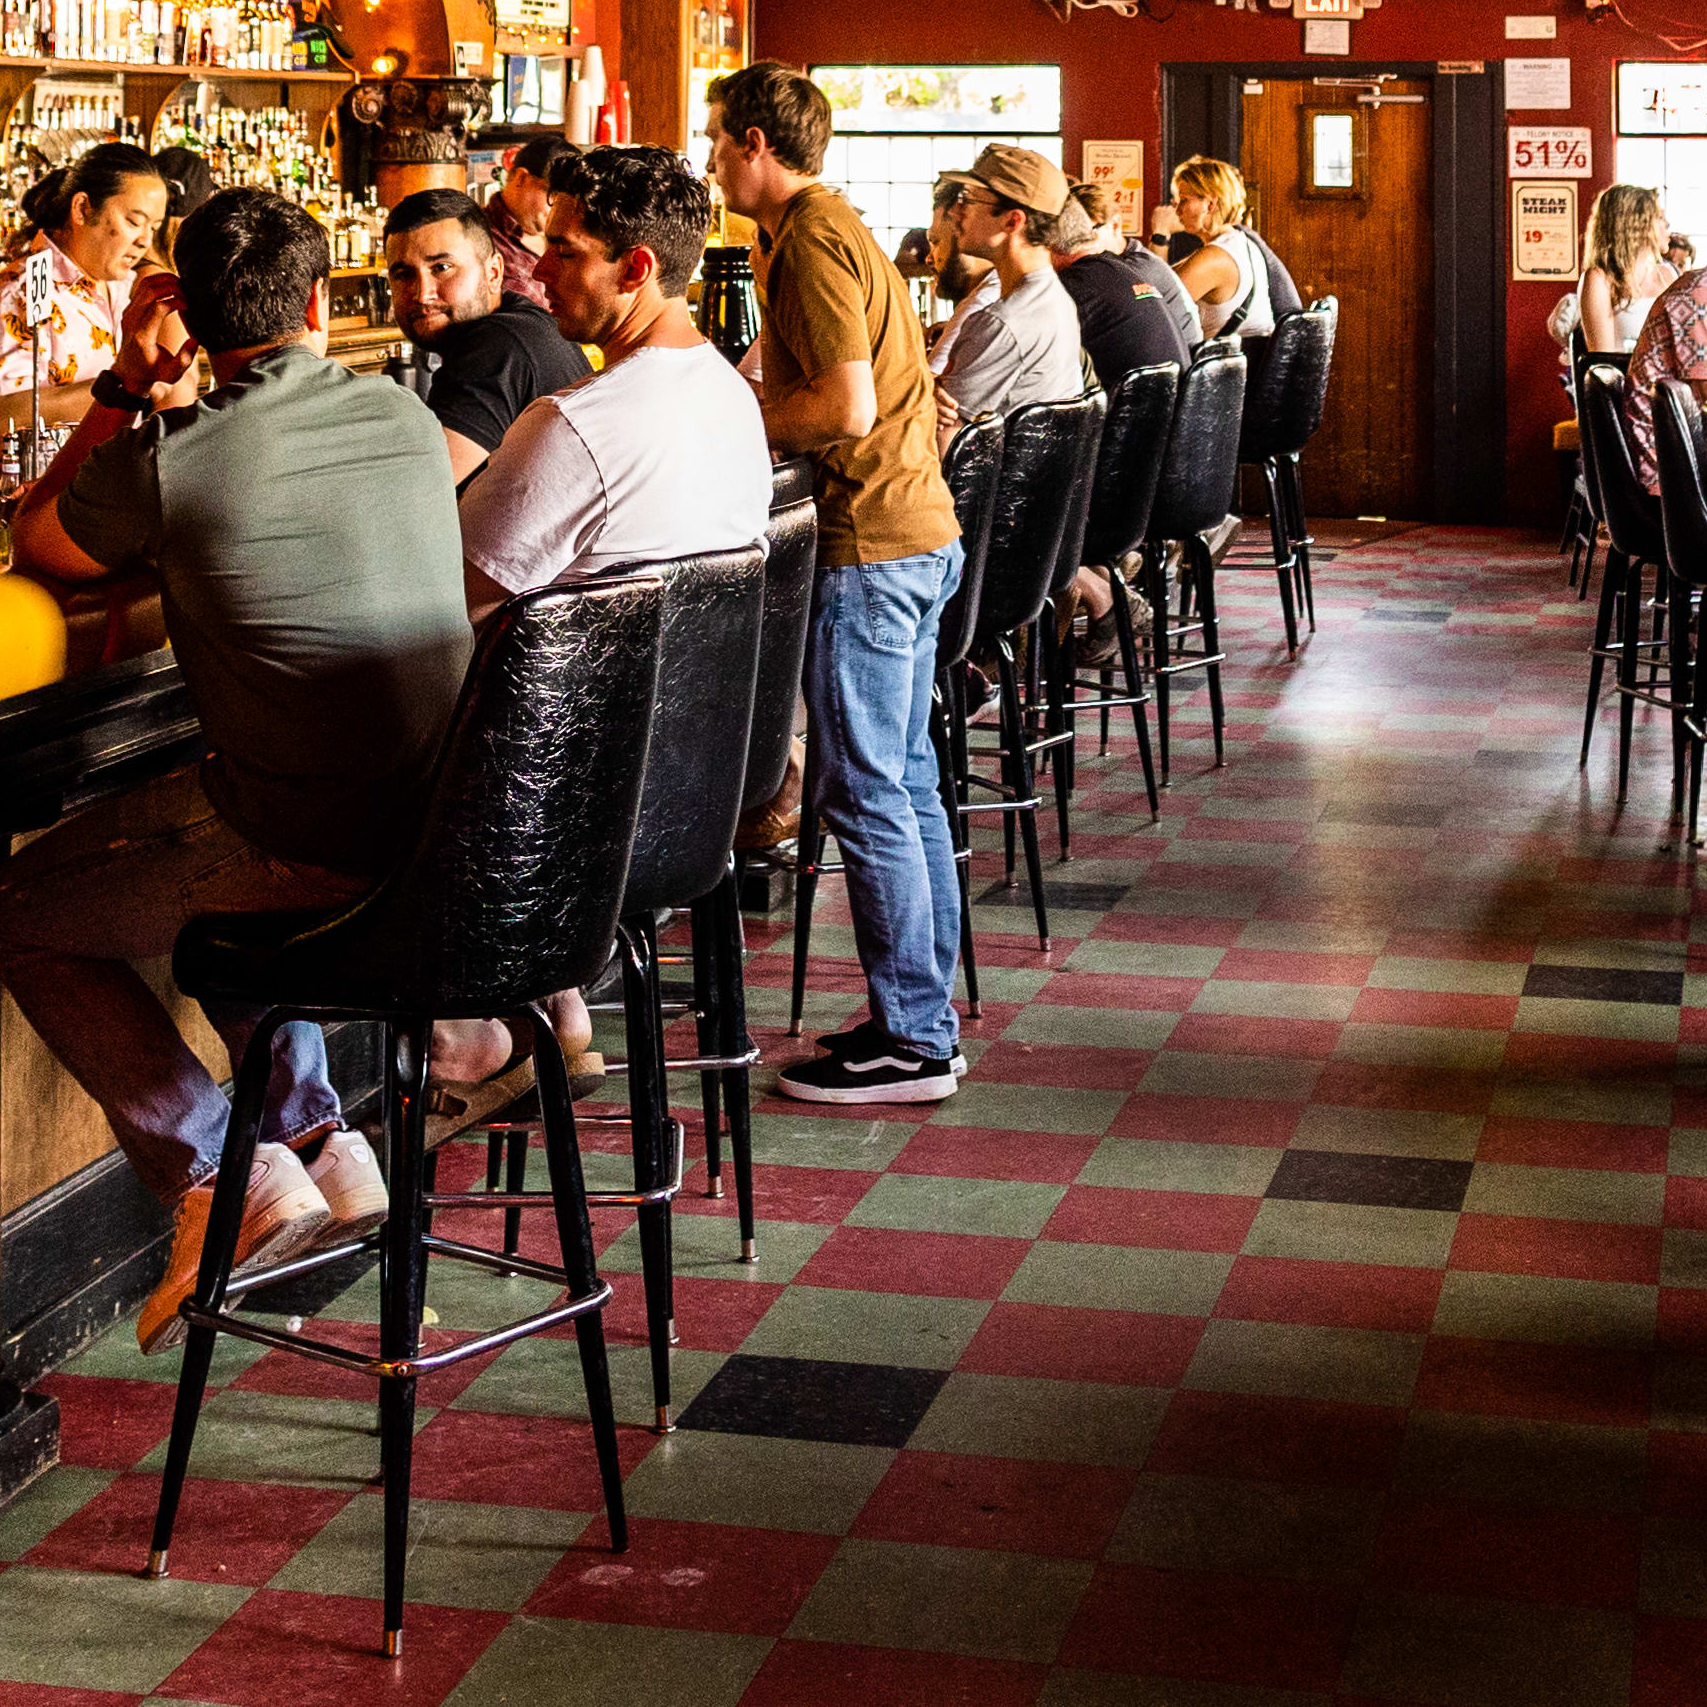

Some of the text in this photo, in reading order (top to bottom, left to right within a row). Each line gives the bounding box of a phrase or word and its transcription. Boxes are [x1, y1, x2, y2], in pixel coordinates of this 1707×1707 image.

[1515, 140, 1587, 168] 51%
[1522, 197, 1567, 206] STEAK
[31, 257, 47, 303] 56
